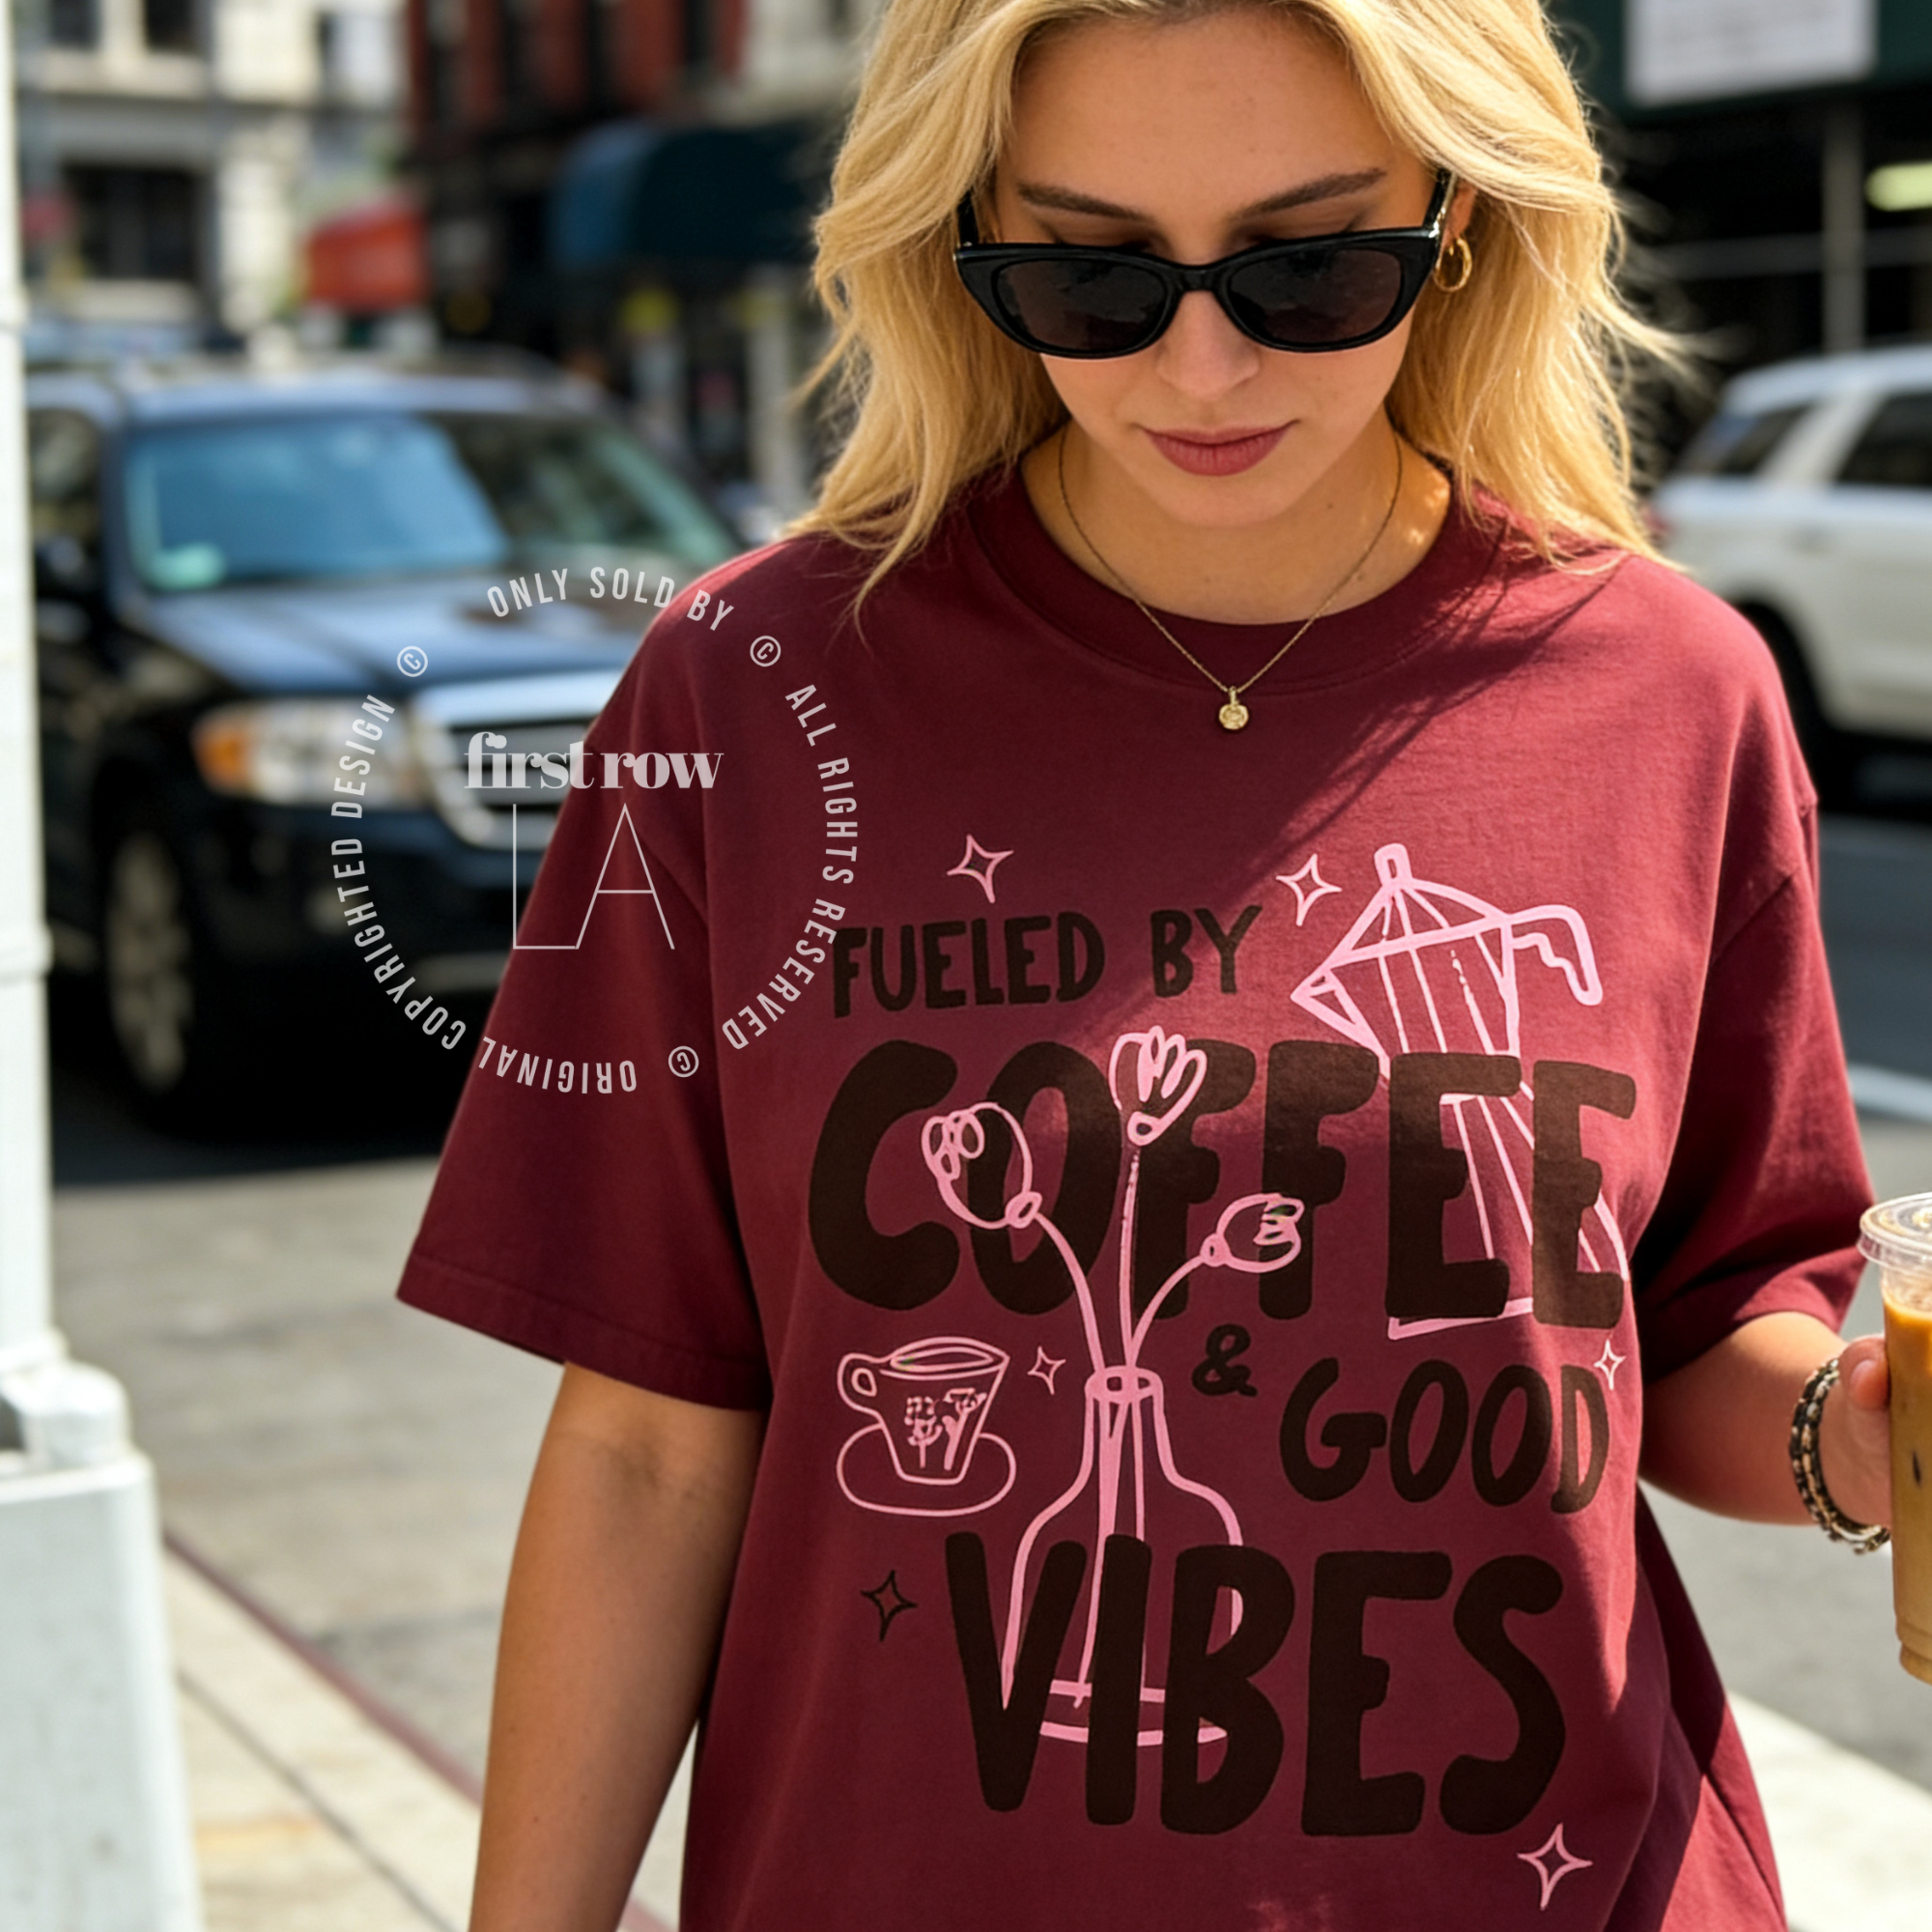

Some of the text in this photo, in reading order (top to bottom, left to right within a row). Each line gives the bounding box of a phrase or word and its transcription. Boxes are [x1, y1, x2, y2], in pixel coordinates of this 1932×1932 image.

[833, 904, 1264, 1018] FUELED BY
[808, 1039, 1637, 1329] COFFEE
[1191, 1323, 1611, 1514] & GOOD
[944, 1530, 1567, 1836] VIBES
